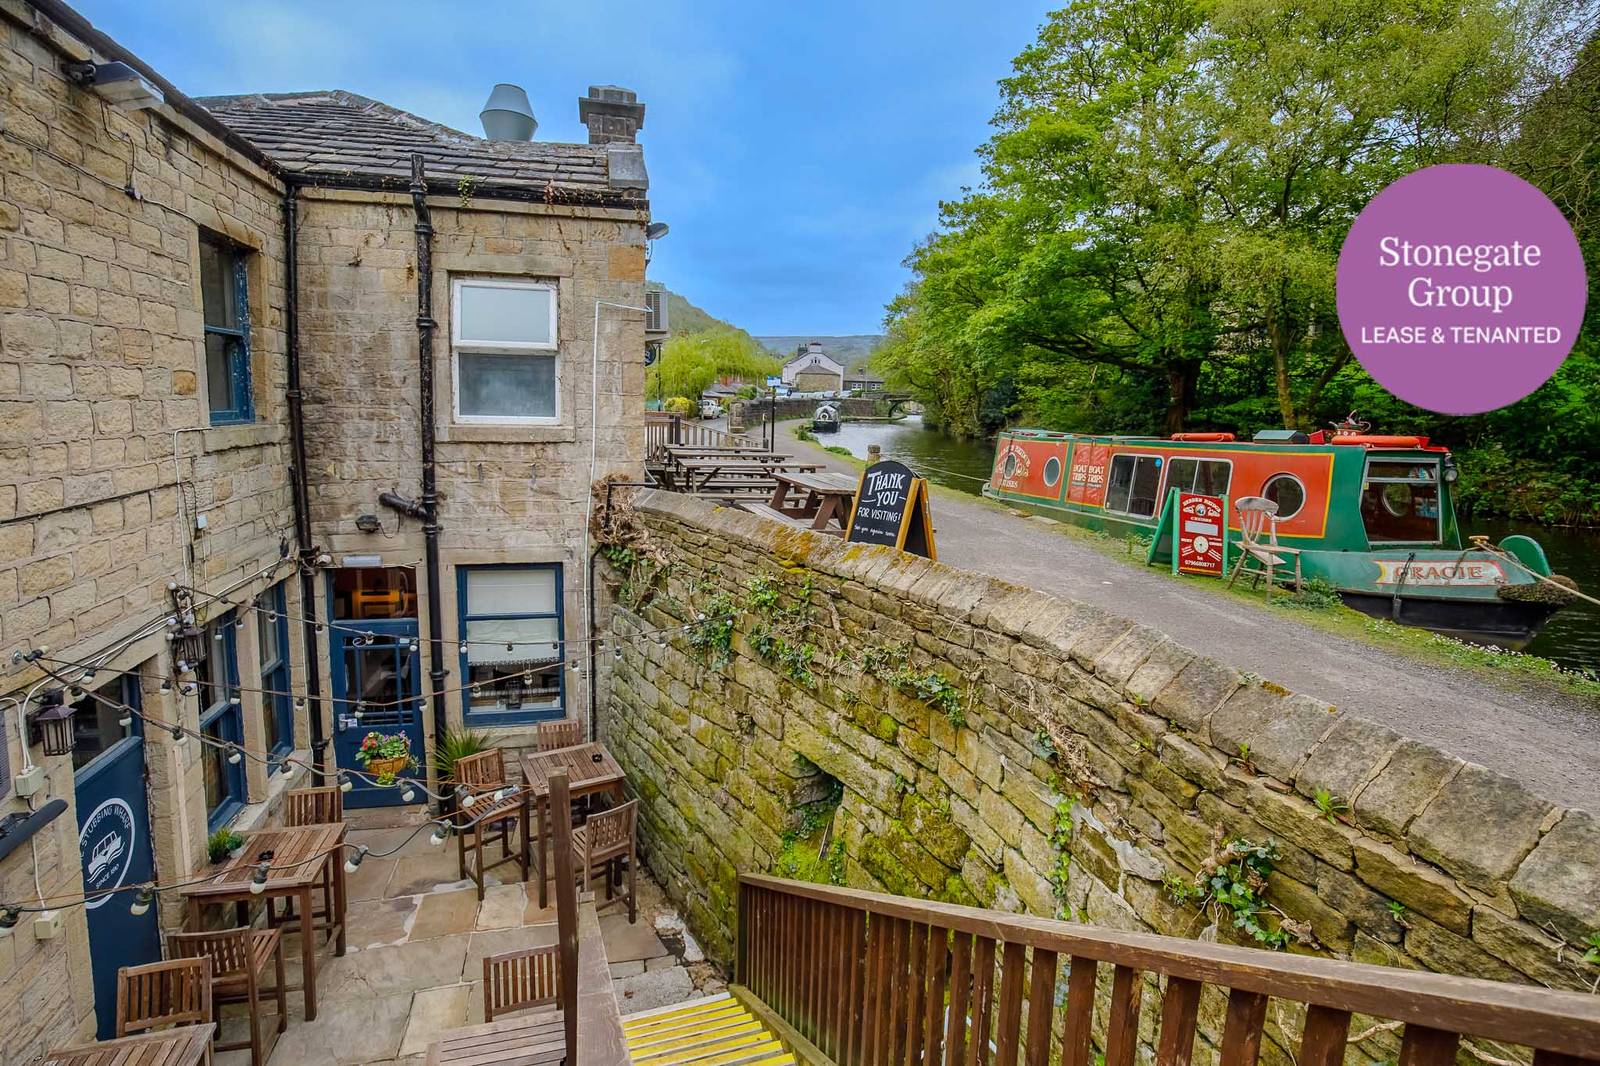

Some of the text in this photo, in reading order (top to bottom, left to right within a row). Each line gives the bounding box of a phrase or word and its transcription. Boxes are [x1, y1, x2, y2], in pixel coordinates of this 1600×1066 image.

[1088, 465, 1105, 474] BOAT
[867, 471, 906, 496] THANK
[1087, 474, 1104, 483] TRIPS
[876, 491, 899, 507] YOU
[857, 506, 902, 524] FOR VISITING!
[1394, 566, 1484, 580] GRACIE
[81, 804, 132, 847] STUBBING WHARF
